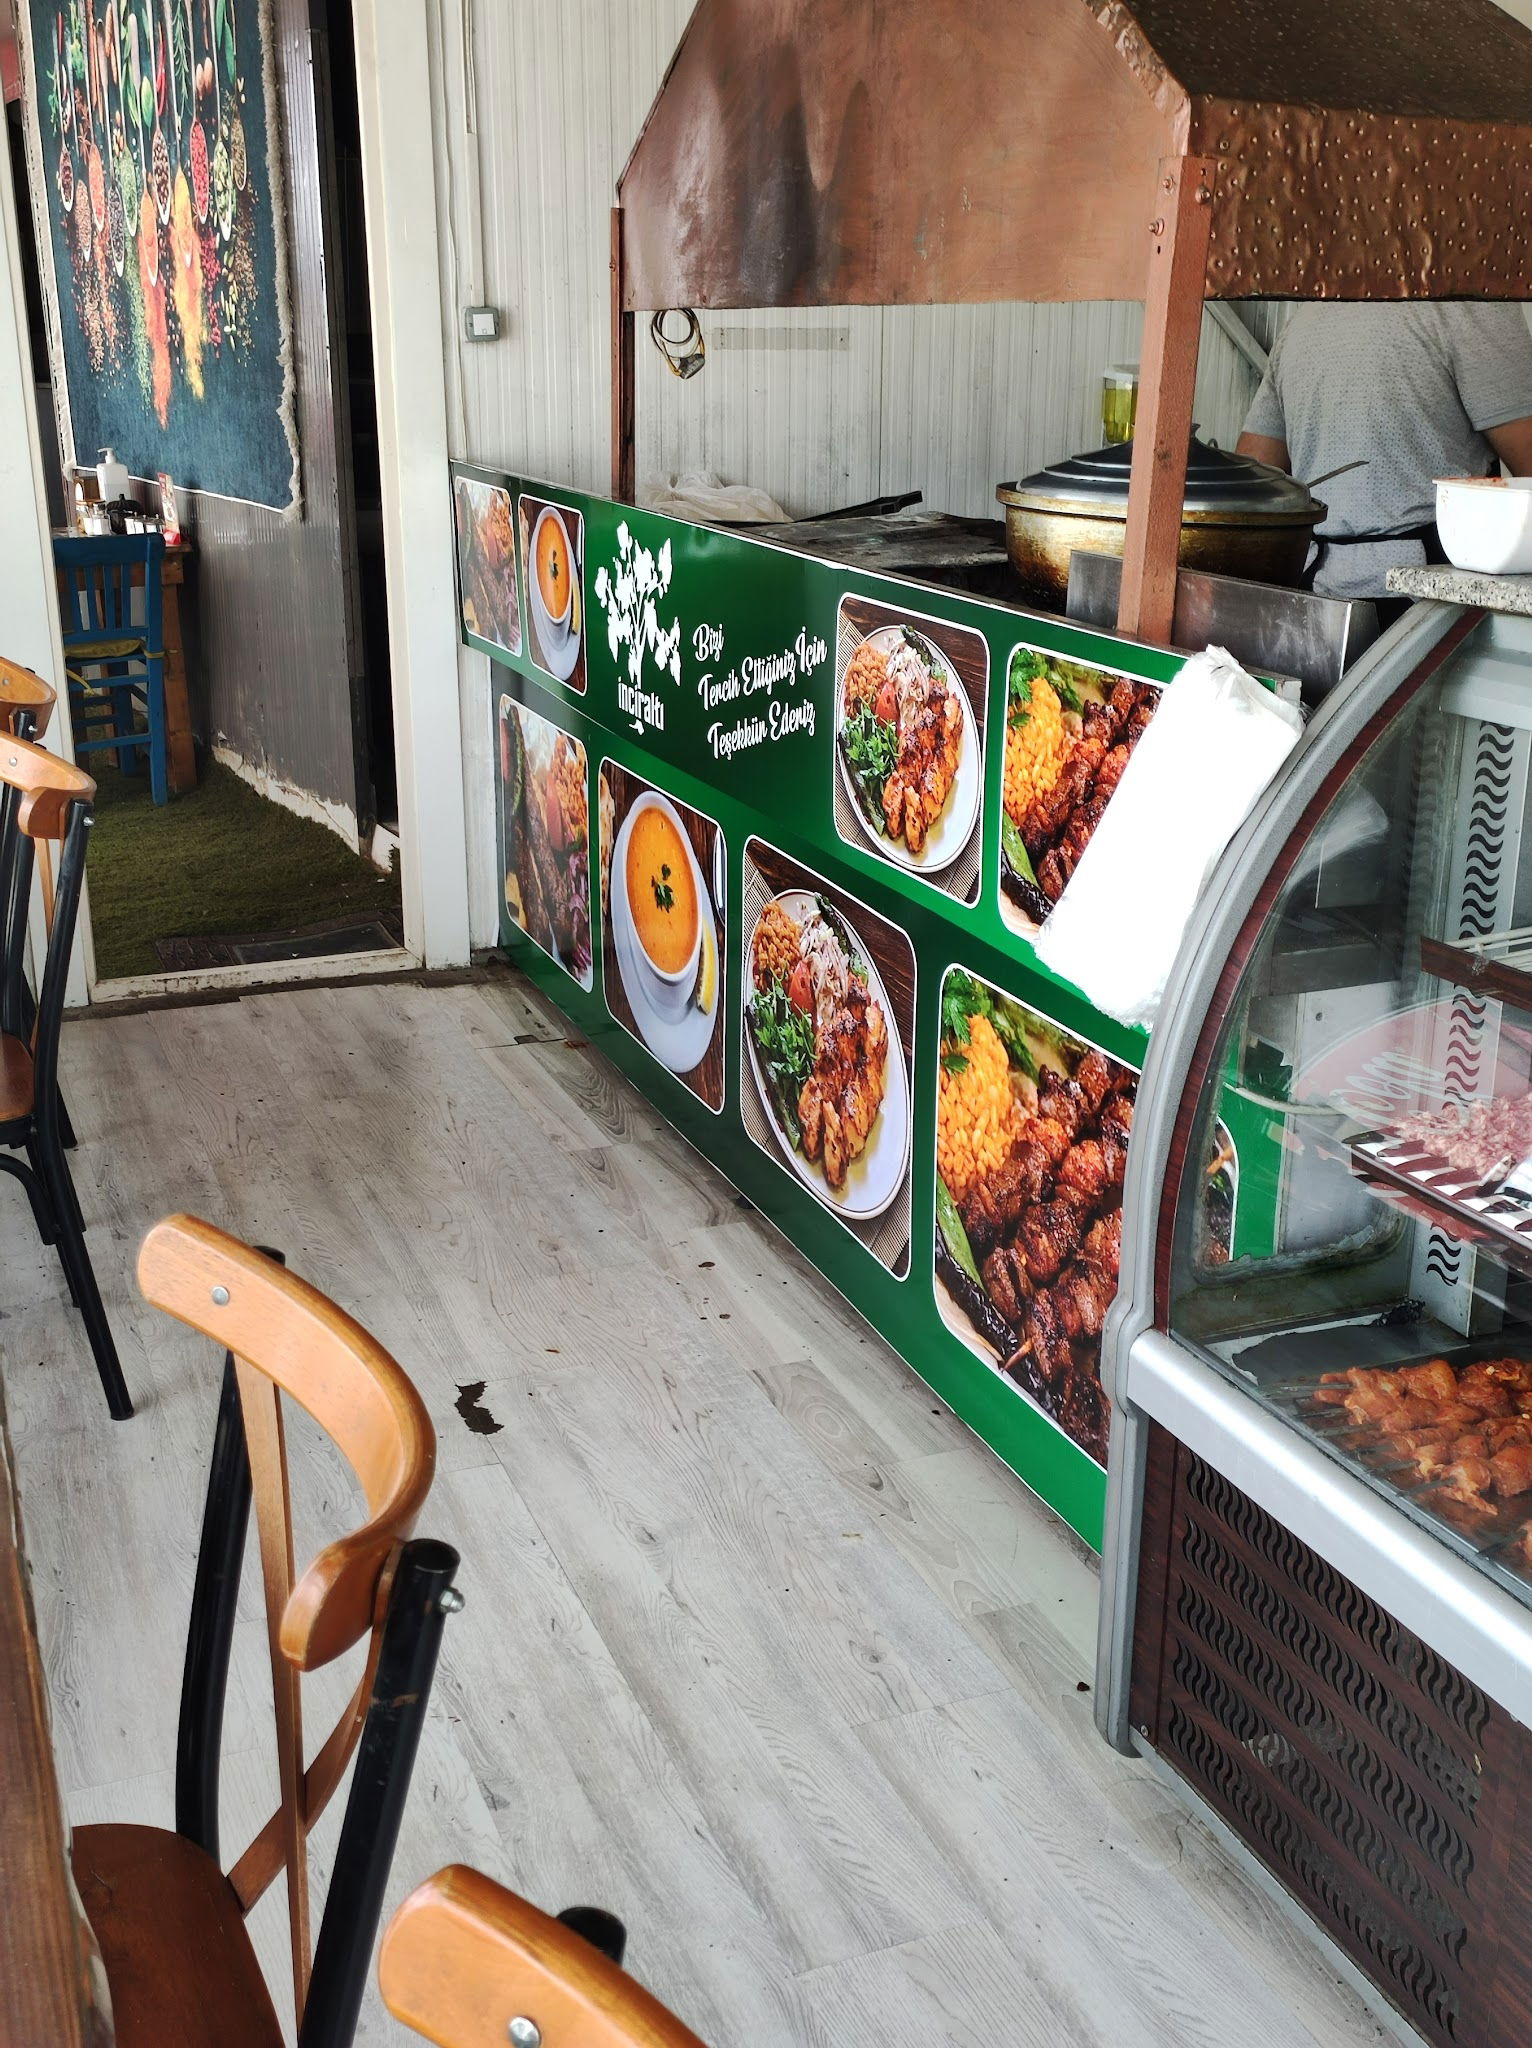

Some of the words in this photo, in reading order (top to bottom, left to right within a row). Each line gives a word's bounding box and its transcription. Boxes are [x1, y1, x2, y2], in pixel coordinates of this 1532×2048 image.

[692, 623, 724, 662] Bizi
[697, 668, 741, 711] Tercih
[741, 648, 797, 696] Ettiğiniz
[794, 625, 828, 677] İçin
[706, 716, 768, 761] Teşekkür
[768, 698, 816, 741] Ederiz
